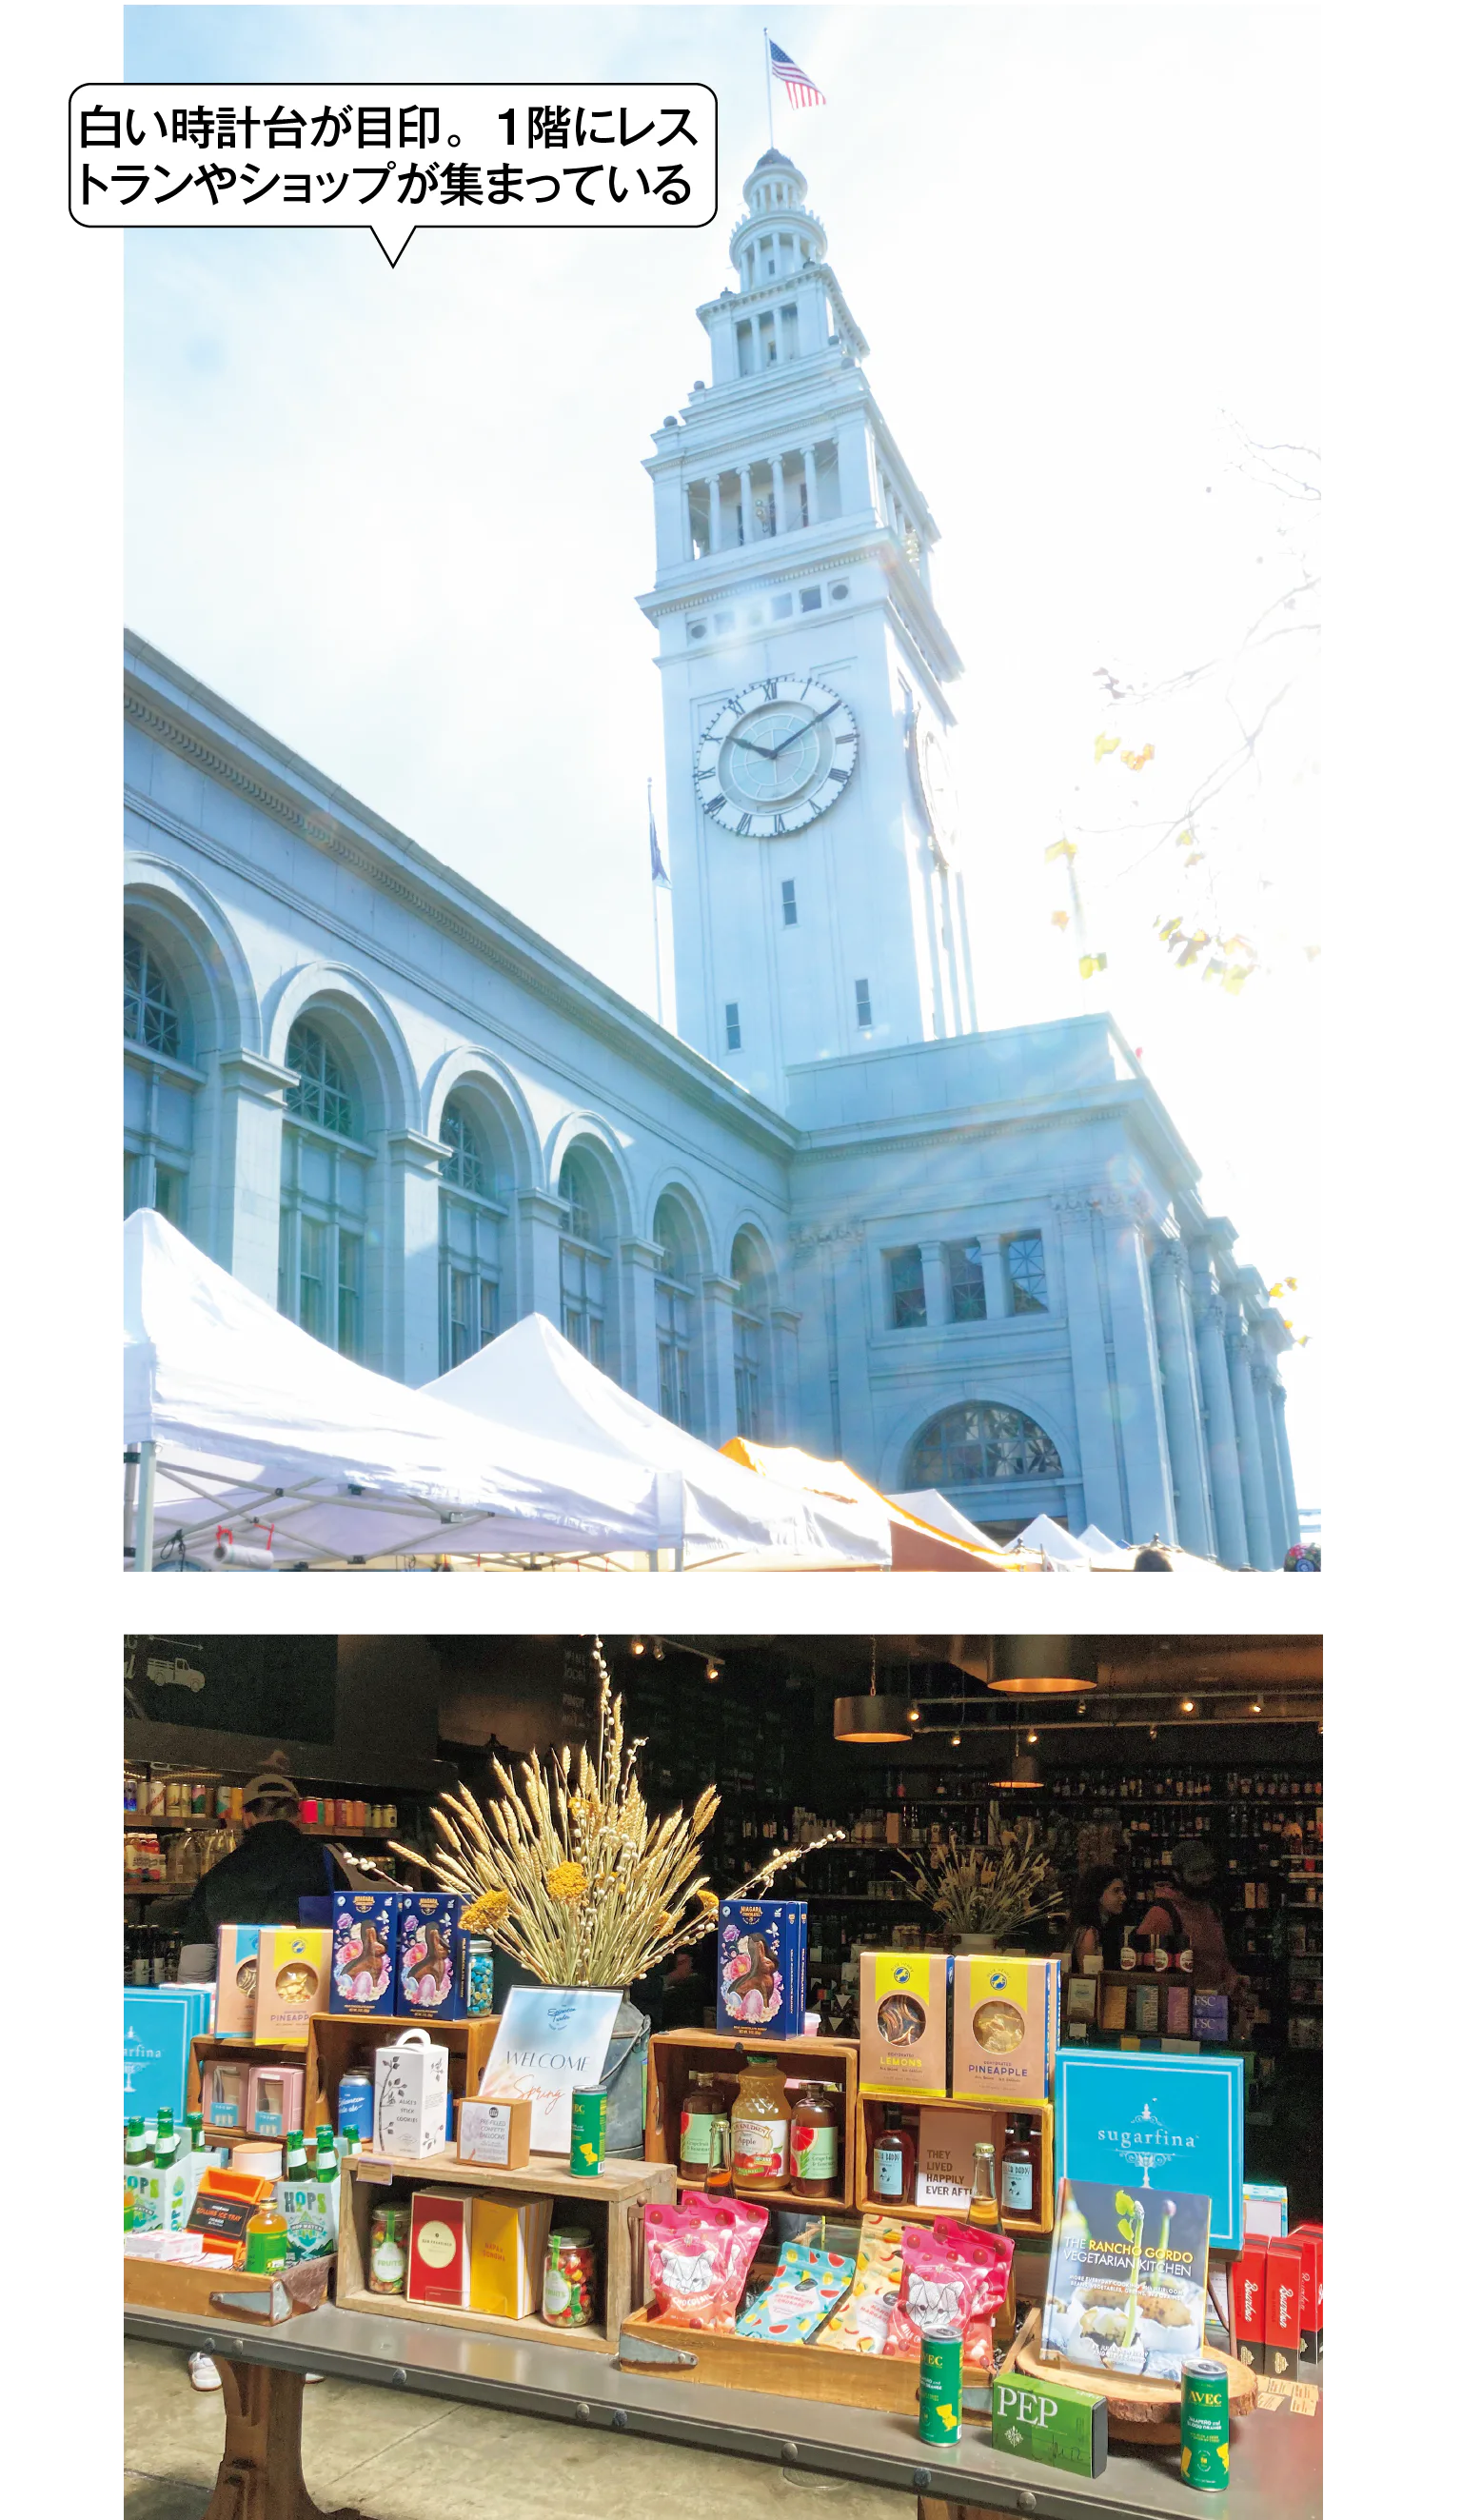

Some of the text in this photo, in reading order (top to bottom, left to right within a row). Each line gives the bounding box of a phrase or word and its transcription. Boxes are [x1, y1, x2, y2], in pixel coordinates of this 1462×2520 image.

[1195, 1995, 1216, 2007] FSC
[506, 2051, 590, 2072] WELCOME
[879, 2056, 922, 2067] LEMONS
[968, 2064, 1028, 2076] PINEAPPLE
[513, 2074, 565, 2114] Spring
[738, 2137, 757, 2146] Apple
[1097, 2129, 1195, 2148] sugarfina
[926, 2149, 951, 2159] THEY
[926, 2162, 953, 2172] LIVED
[926, 2173, 964, 2184] HAPPILY
[925, 2186, 949, 2195] EVER
[228, 2213, 242, 2222] TRAY
[1066, 2237, 1193, 2263] THE RANCHO GORDO
[1064, 2251, 1192, 2276] VEGETARIAN KITCHEN
[1244, 2279, 1258, 2323] Bourbon
[1279, 2284, 1294, 2330] Bourbon
[900, 2324, 914, 2339] MILK
[1189, 2391, 1222, 2406] AVEC
[998, 2385, 1058, 2429] PEP
